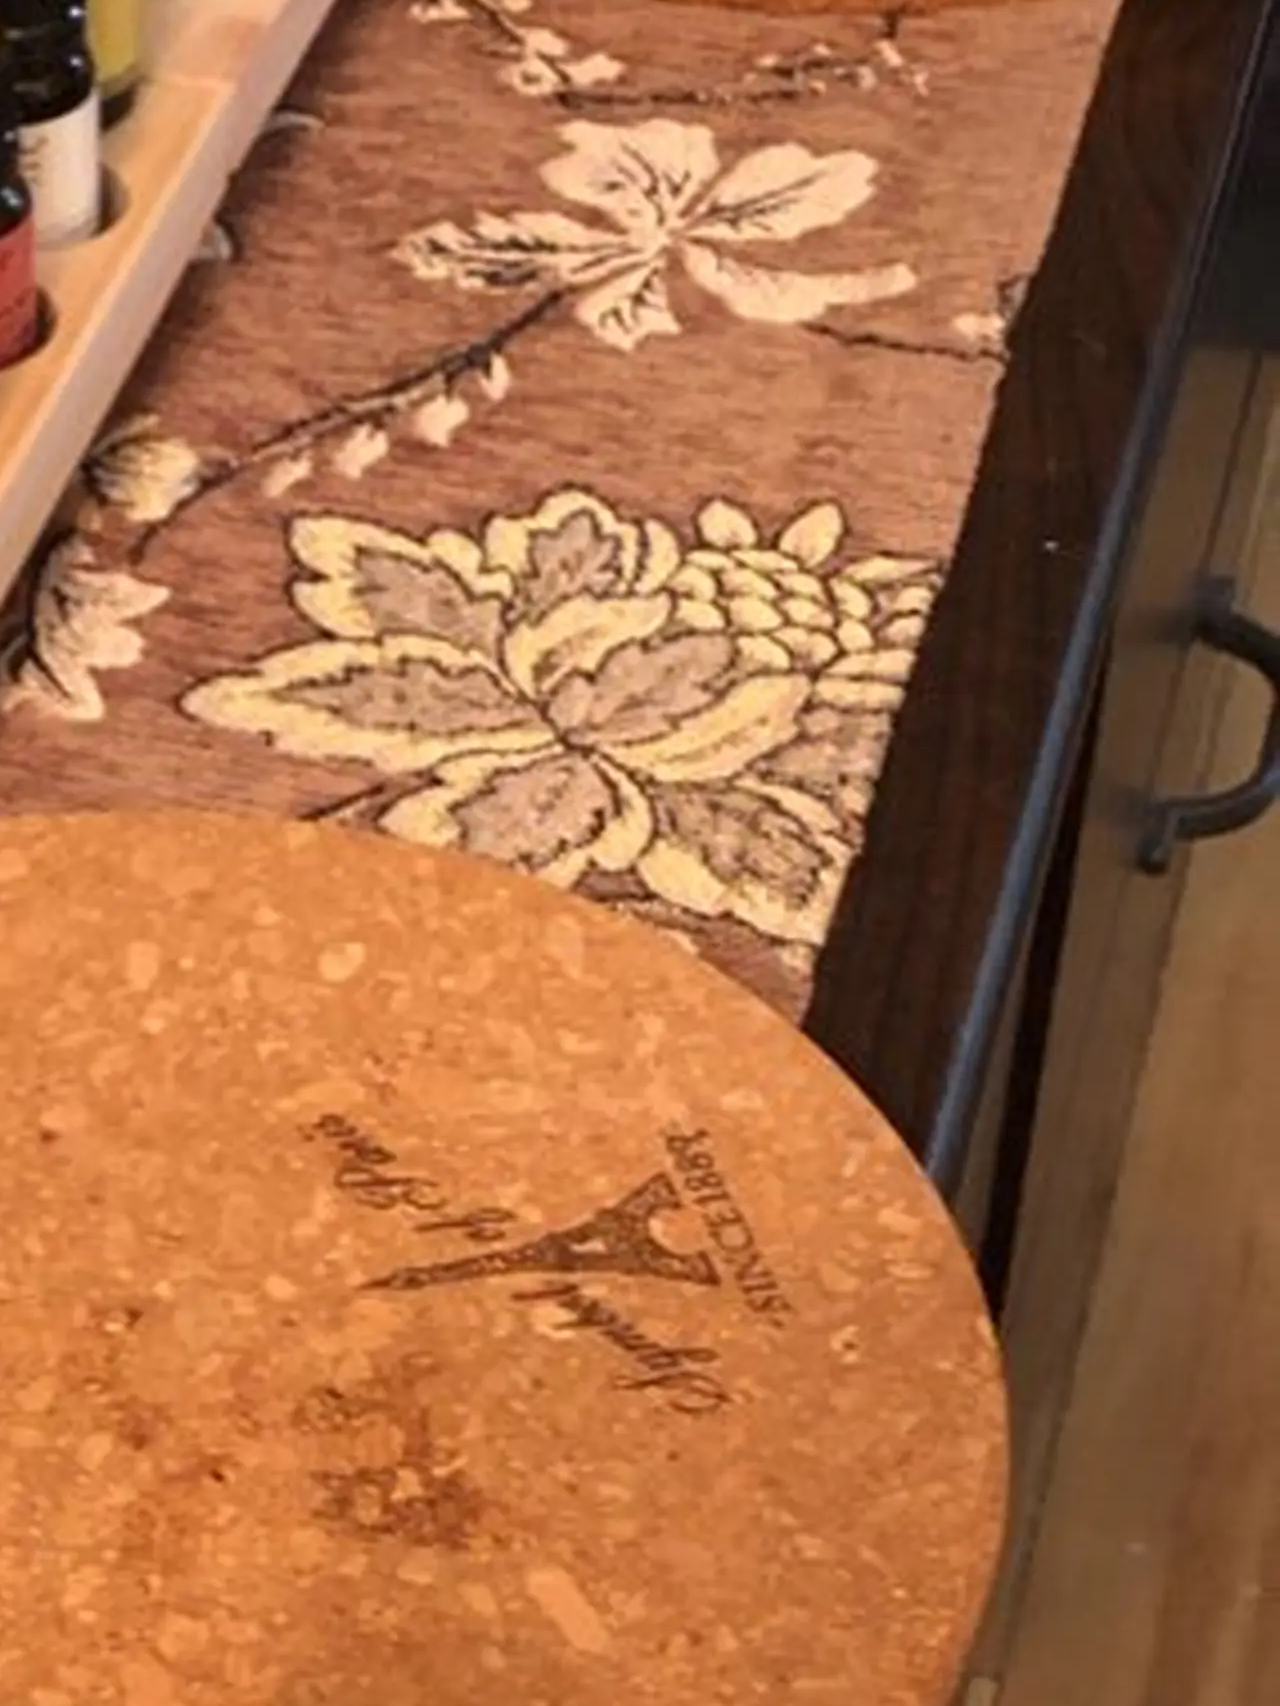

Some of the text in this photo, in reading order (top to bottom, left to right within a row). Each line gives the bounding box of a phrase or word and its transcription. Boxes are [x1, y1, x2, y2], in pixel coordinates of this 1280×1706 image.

[298, 1112, 735, 1415] Symbol of Paris
[702, 1207, 791, 1319] SINCE
